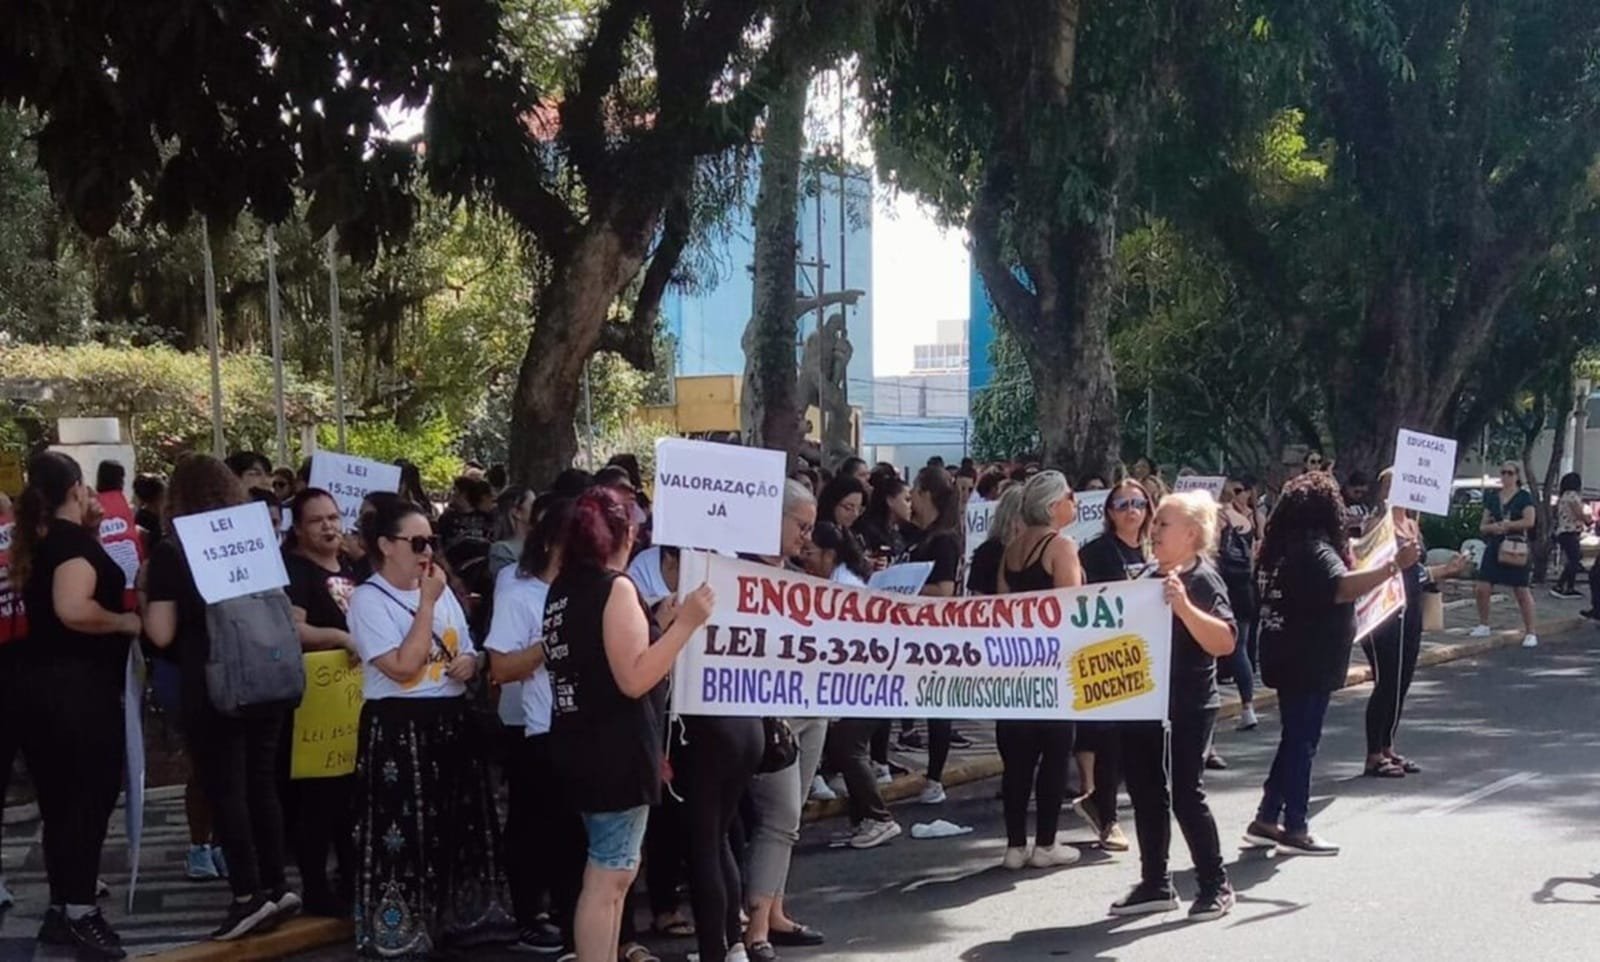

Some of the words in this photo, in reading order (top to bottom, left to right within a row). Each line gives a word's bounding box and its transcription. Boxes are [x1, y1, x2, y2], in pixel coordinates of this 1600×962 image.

[347, 463, 368, 477] LEI
[328, 482, 368, 498] 15.326
[660, 473, 779, 498] VALORAZAÇÃO
[707, 502, 727, 518] JÁ
[210, 516, 233, 533] LEI
[203, 537, 265, 562] 15.326/26
[227, 567, 249, 584] JÁ!
[737, 575, 1062, 629] ENQUADRAMENTO
[1070, 587, 1124, 629] JÁ!
[703, 625, 767, 658] LEI
[984, 635, 1063, 670] CUIDAR,
[1078, 651, 1089, 679] É
[1089, 642, 1142, 675] FUNÇÃO
[702, 667, 809, 709] BRINCAR,
[816, 671, 909, 708] EDUCAR.
[916, 670, 946, 708] SÃO
[950, 671, 1059, 709] INDISSOCIÁVEIS!
[1083, 672, 1145, 704] DOCENTE!
